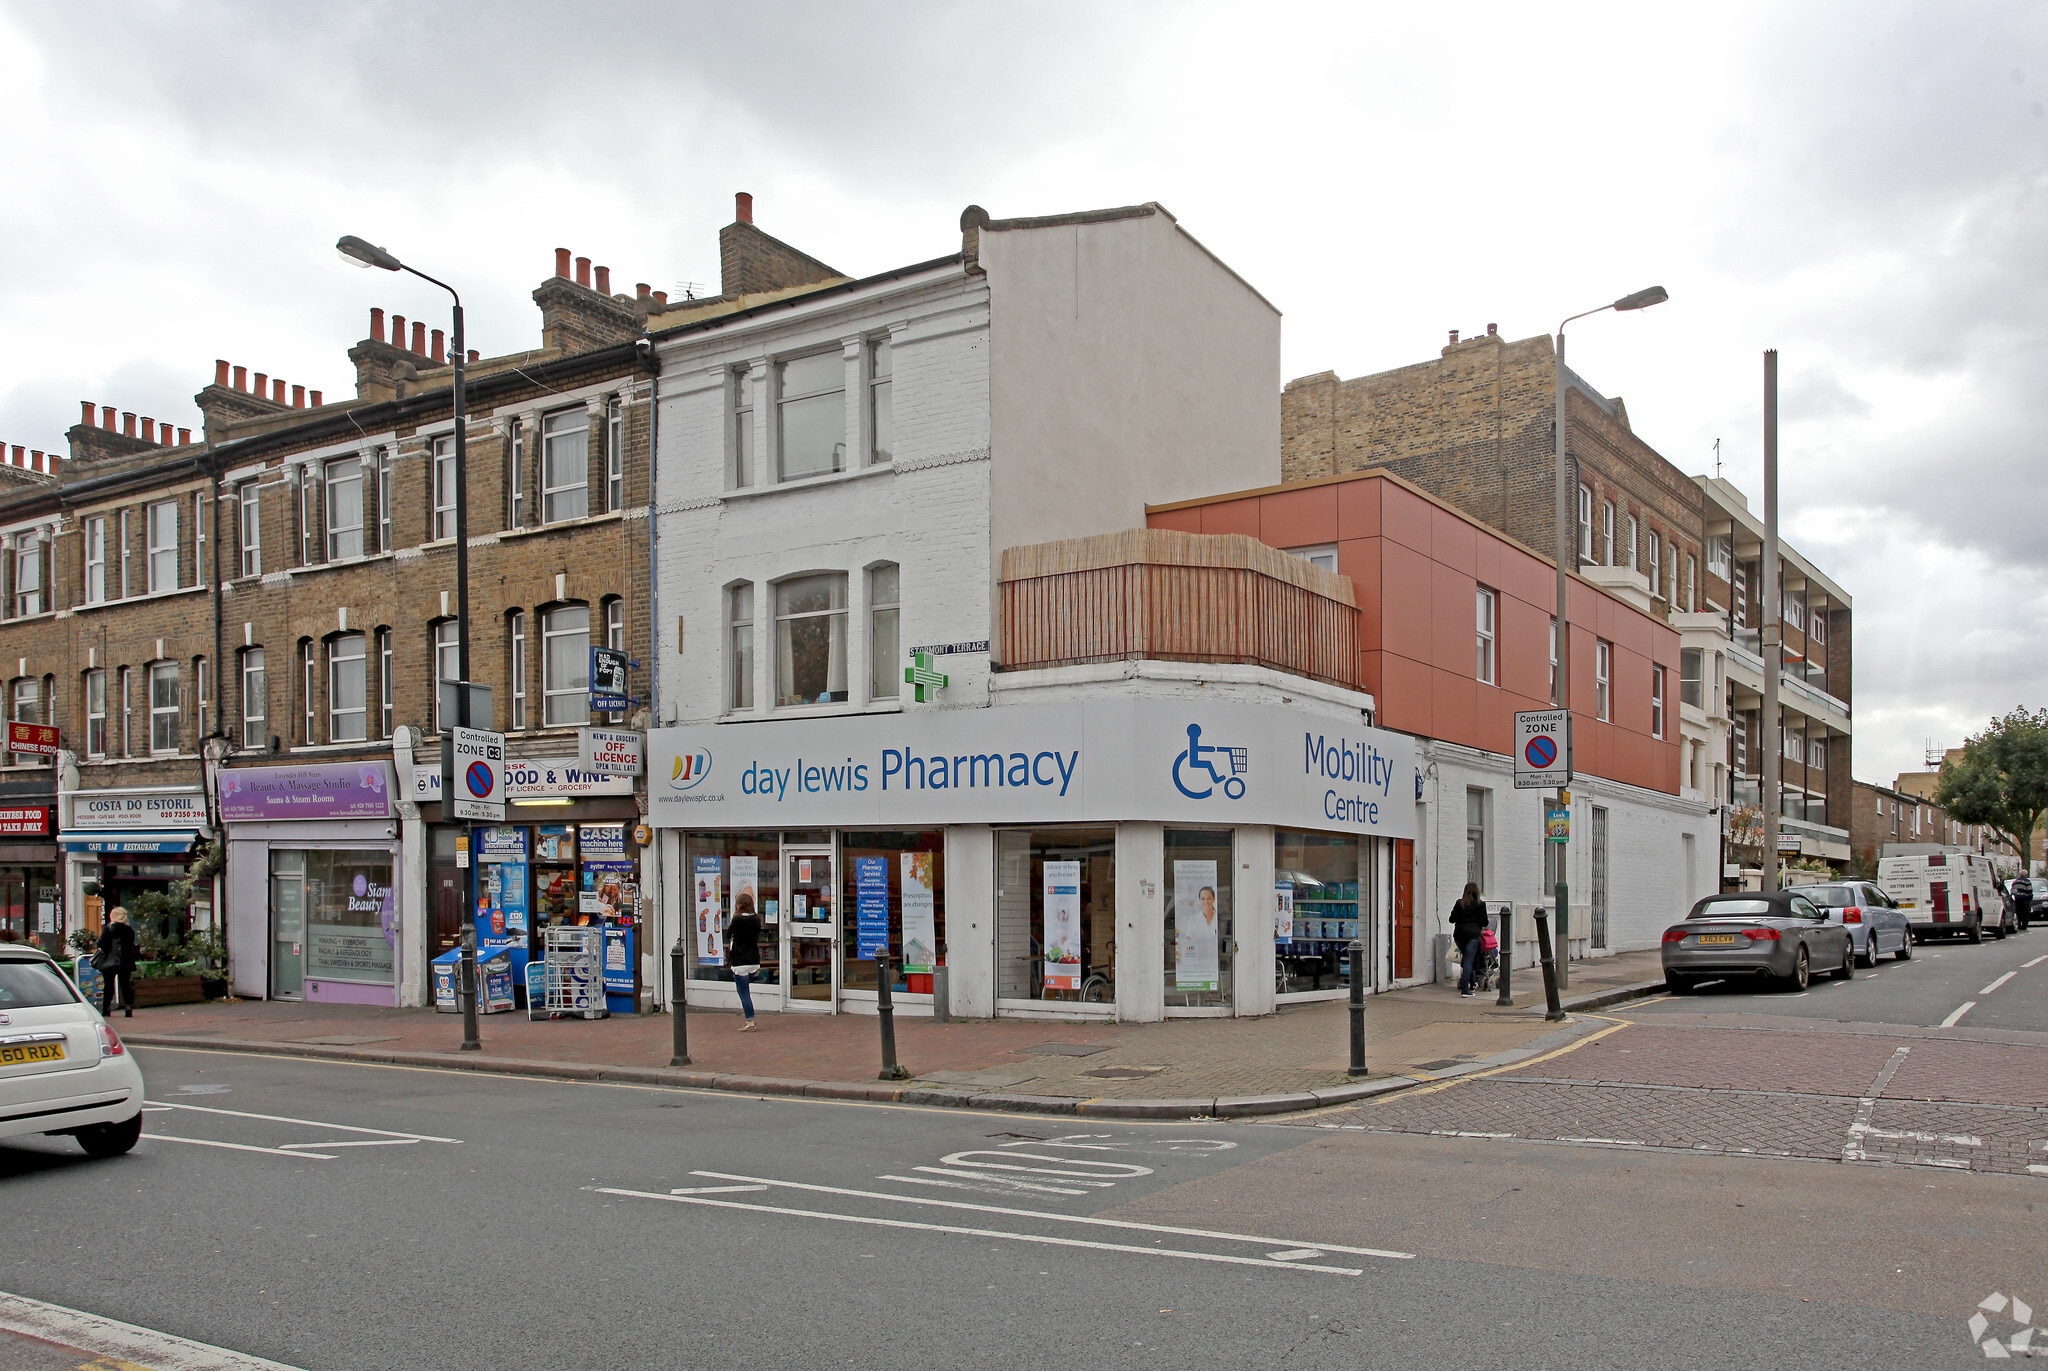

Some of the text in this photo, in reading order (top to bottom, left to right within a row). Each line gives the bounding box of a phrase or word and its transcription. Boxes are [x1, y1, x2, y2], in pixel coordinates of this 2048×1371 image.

[953, 641, 985, 652] TERRACE
[597, 700, 626, 708] OFF LICENCE
[1520, 713, 1563, 722] Controlled
[1526, 723, 1557, 733] ZONE
[15, 726, 54, 743] 香港
[460, 731, 498, 744] Controlled
[616, 735, 638, 743] GROCERY
[11, 741, 56, 754] CHINESE FOOD
[457, 743, 501, 758] ZONE C3
[605, 742, 625, 752] OFF
[593, 752, 637, 764] LICENCE
[596, 762, 636, 772] OPEN TILL LATE
[1305, 732, 1393, 797] Mobility
[505, 770, 539, 785] OOD
[546, 770, 557, 784] &
[565, 769, 610, 783] WINE
[741, 746, 1079, 801] day lewis Pharmacy
[250, 778, 351, 794] Beauty & Massage Studio
[266, 796, 284, 804] Sauna
[292, 795, 310, 803] Steam
[312, 794, 335, 803] Rooms
[658, 794, 725, 803] www.daylewisplc.co.uk
[89, 798, 194, 812] COSTA DO ESTORIL
[1324, 789, 1379, 825] Centre
[25, 810, 42, 819] FOOD
[3, 822, 43, 832] TAKE AWAY
[485, 832, 523, 842] CH
[579, 828, 623, 840] CASH
[123, 843, 160, 851] RESTAURANT
[580, 840, 623, 848] machine here
[590, 863, 606, 871] oyster
[697, 864, 721, 872] Remedies
[367, 883, 391, 897] Siam
[348, 896, 382, 915] Beauty
[318, 937, 338, 945] WAXING
[354, 960, 371, 968] SPORTS
[372, 962, 393, 970] MASSAGE
[529, 975, 551, 984] cas
[0, 1044, 61, 1062] 60 RDX
